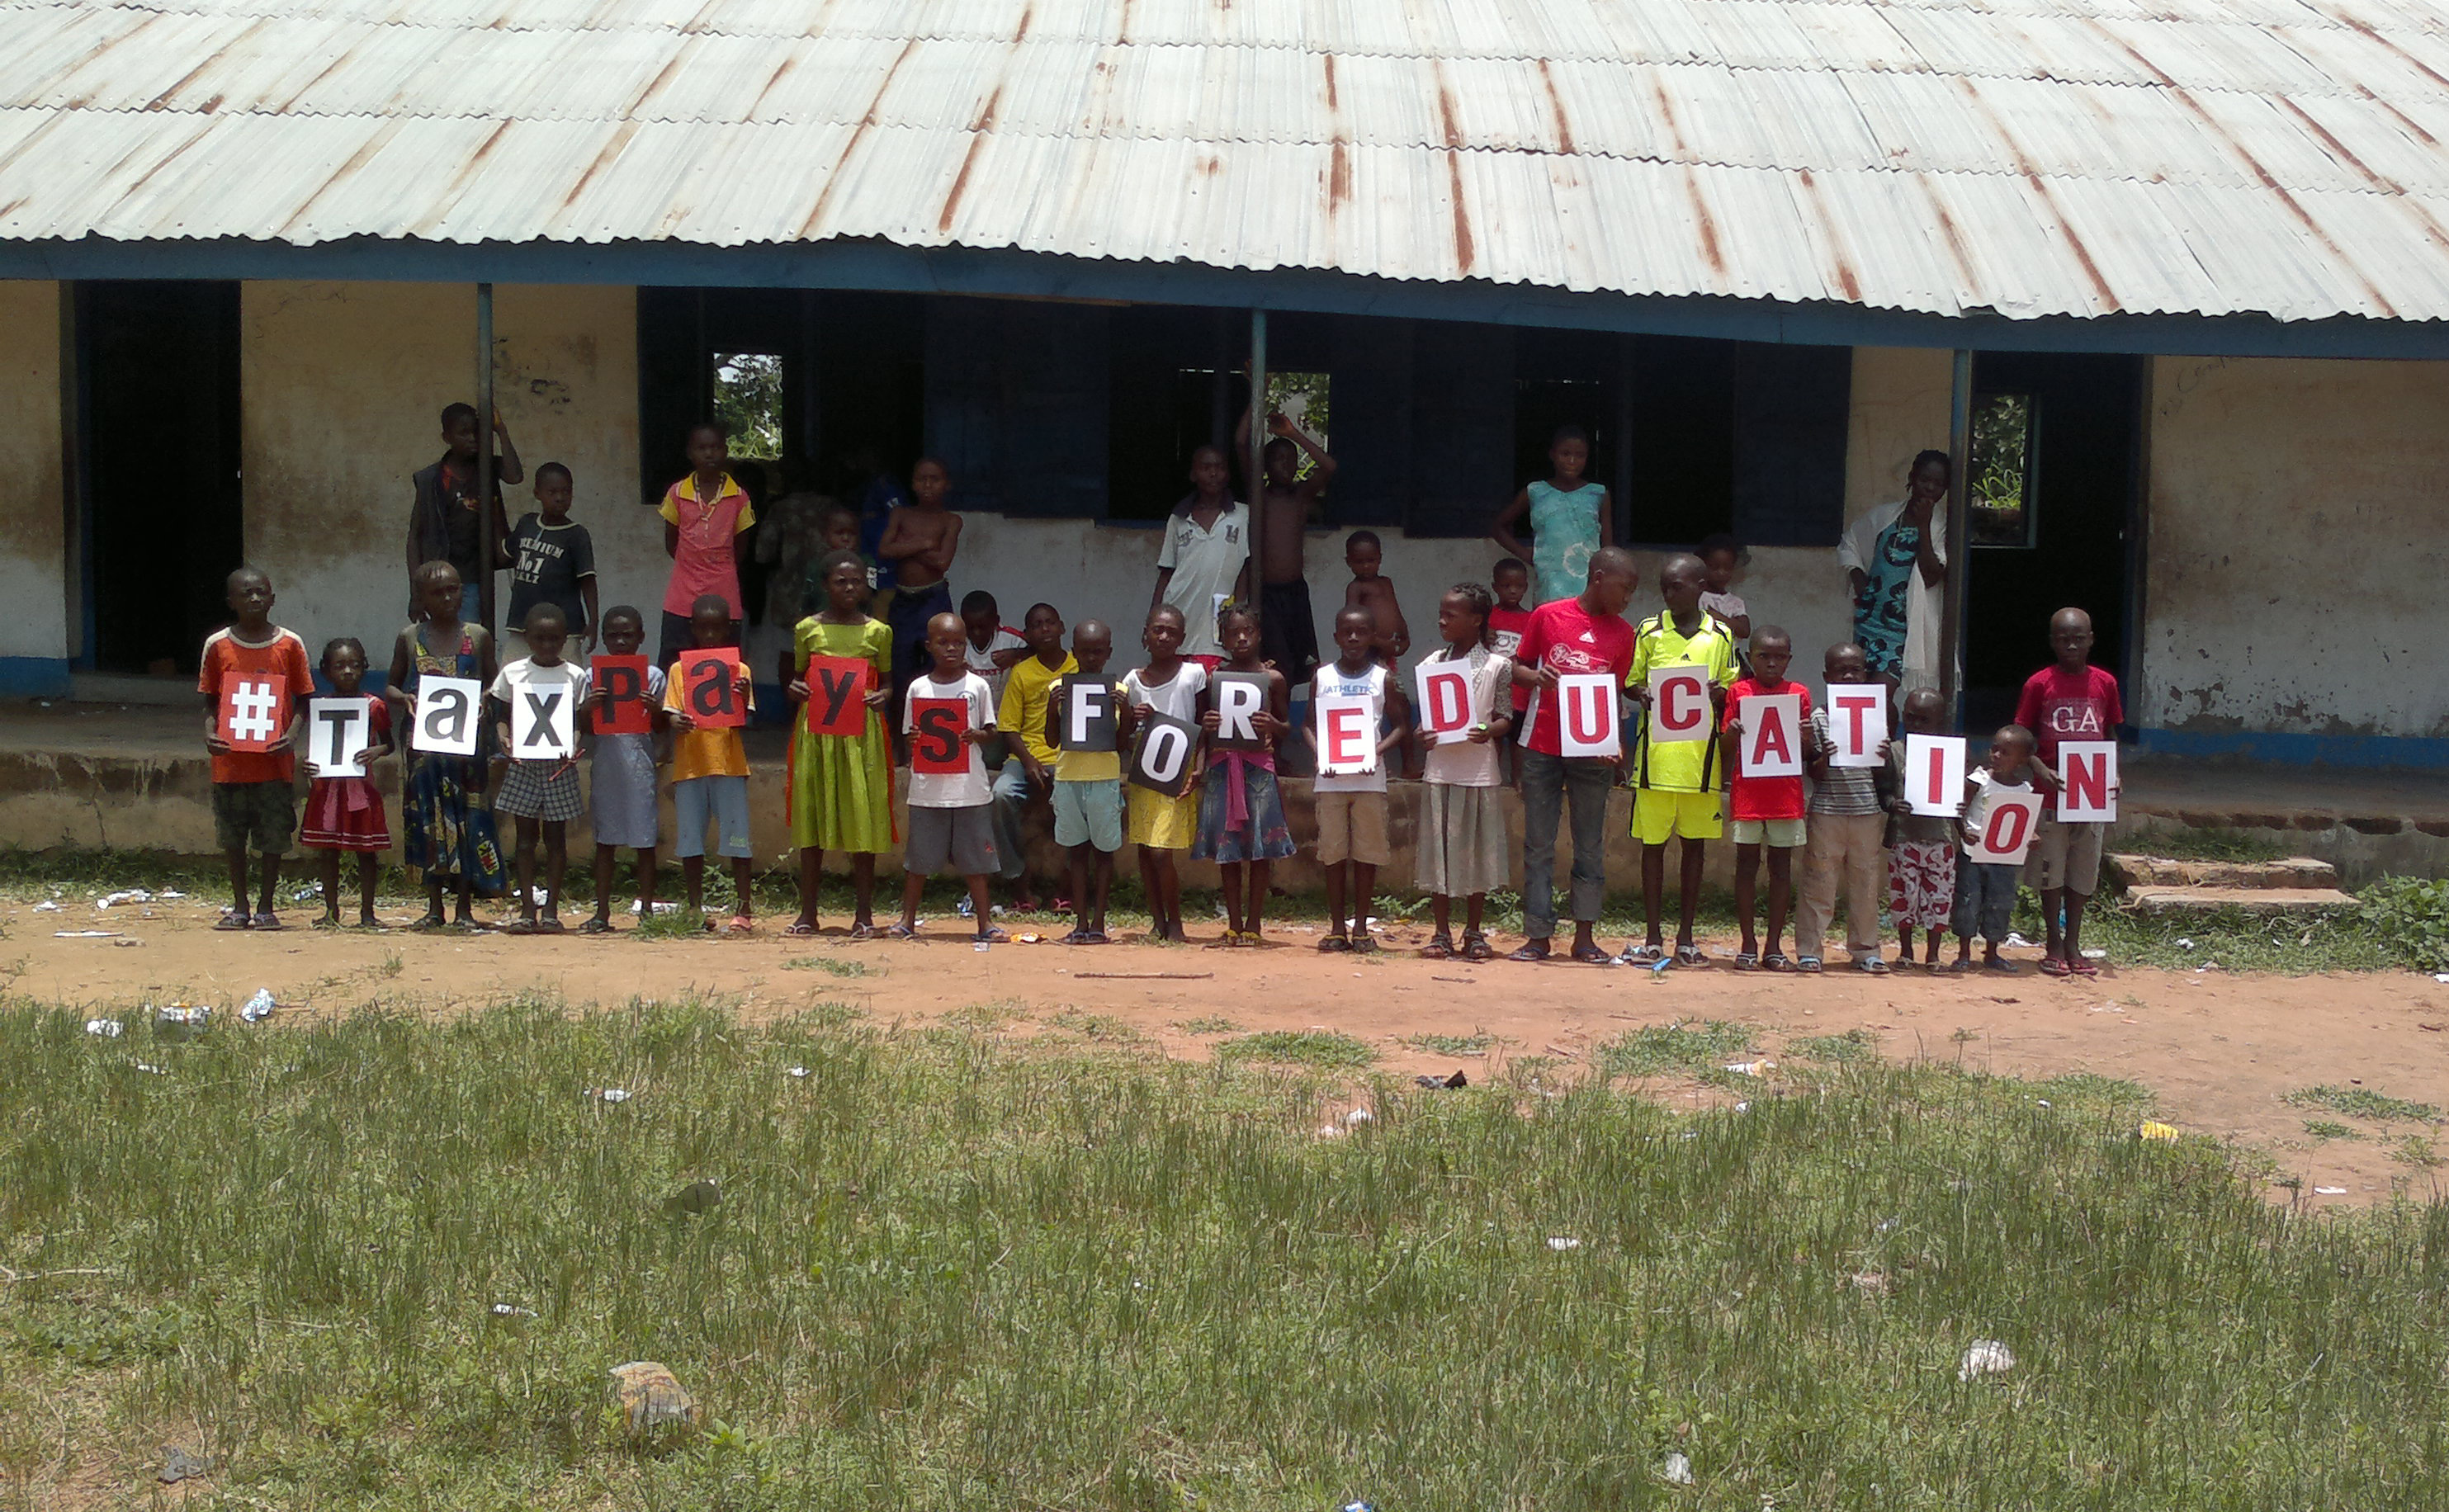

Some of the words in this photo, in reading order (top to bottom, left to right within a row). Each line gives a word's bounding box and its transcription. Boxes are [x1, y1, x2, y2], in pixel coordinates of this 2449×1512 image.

[319, 710, 359, 764] T
[425, 688, 467, 743] a
[691, 659, 734, 716] a
[1072, 684, 1106, 741] F
[1218, 681, 1261, 739] R
[1327, 708, 1364, 763] E
[1429, 673, 1469, 733] D
[1568, 687, 1610, 744] U
[1659, 677, 1701, 730] C
[1755, 707, 1789, 763] A
[1838, 697, 1875, 754] T
[2068, 755, 2106, 808] N
